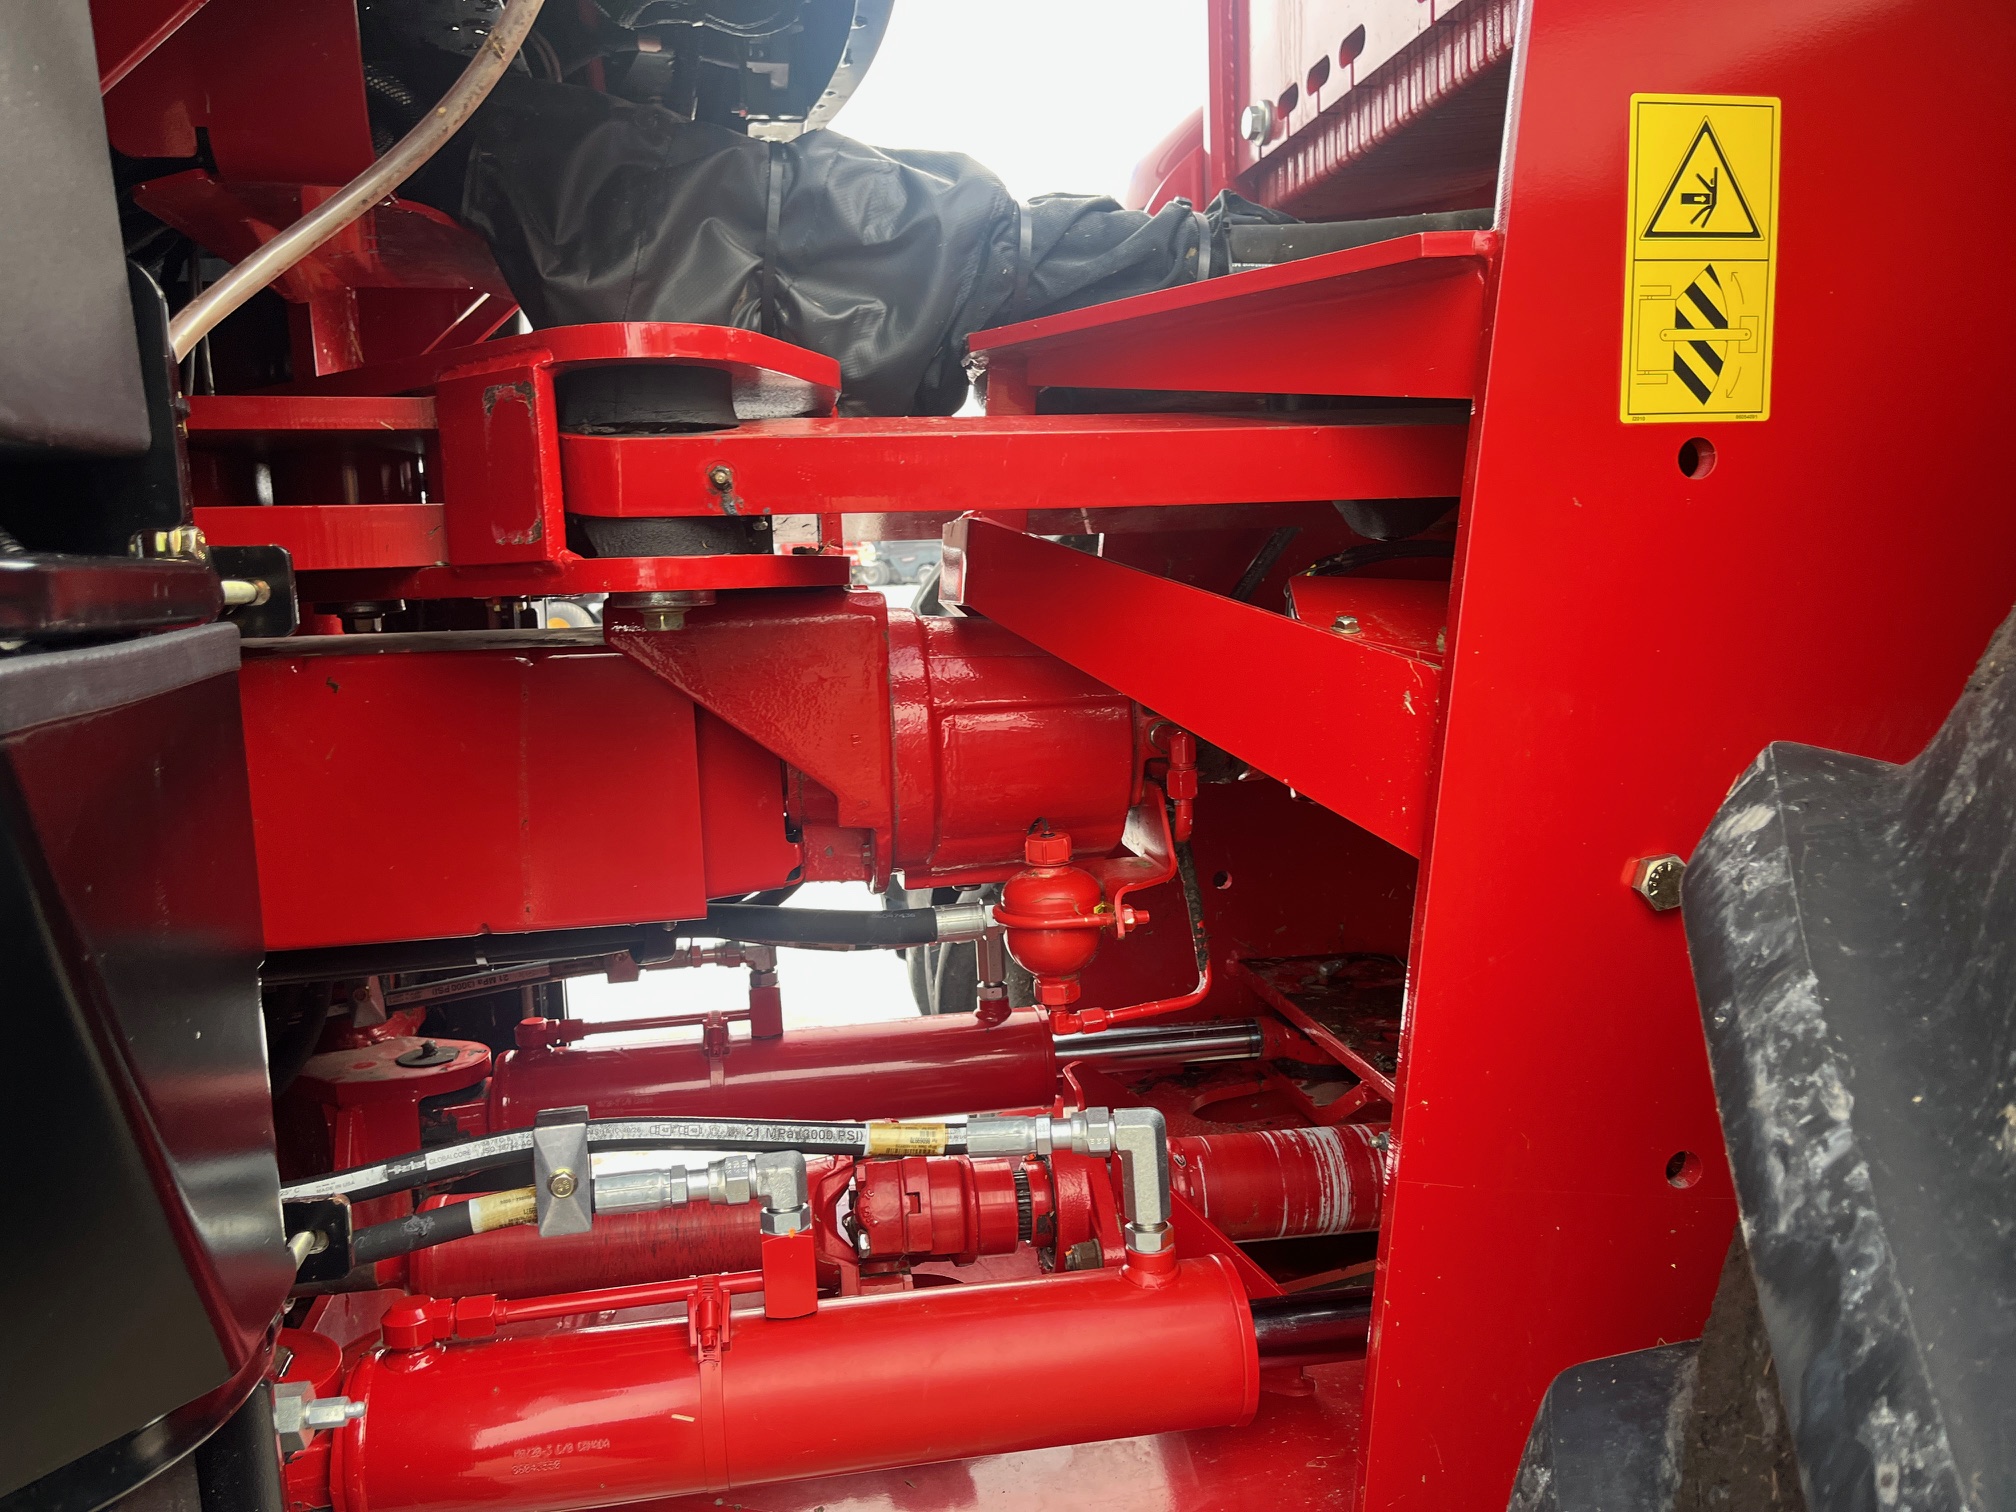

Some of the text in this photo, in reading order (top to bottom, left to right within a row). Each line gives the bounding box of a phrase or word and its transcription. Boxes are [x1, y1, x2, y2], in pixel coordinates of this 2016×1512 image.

[745, 1126, 760, 1138] 21
[766, 1127, 794, 1140] MPa
[838, 1130, 864, 1143] PSI)
[429, 1150, 471, 1164] GLOBALCORE
[316, 1185, 333, 1194] MADE
[343, 1180, 356, 1188] USA
